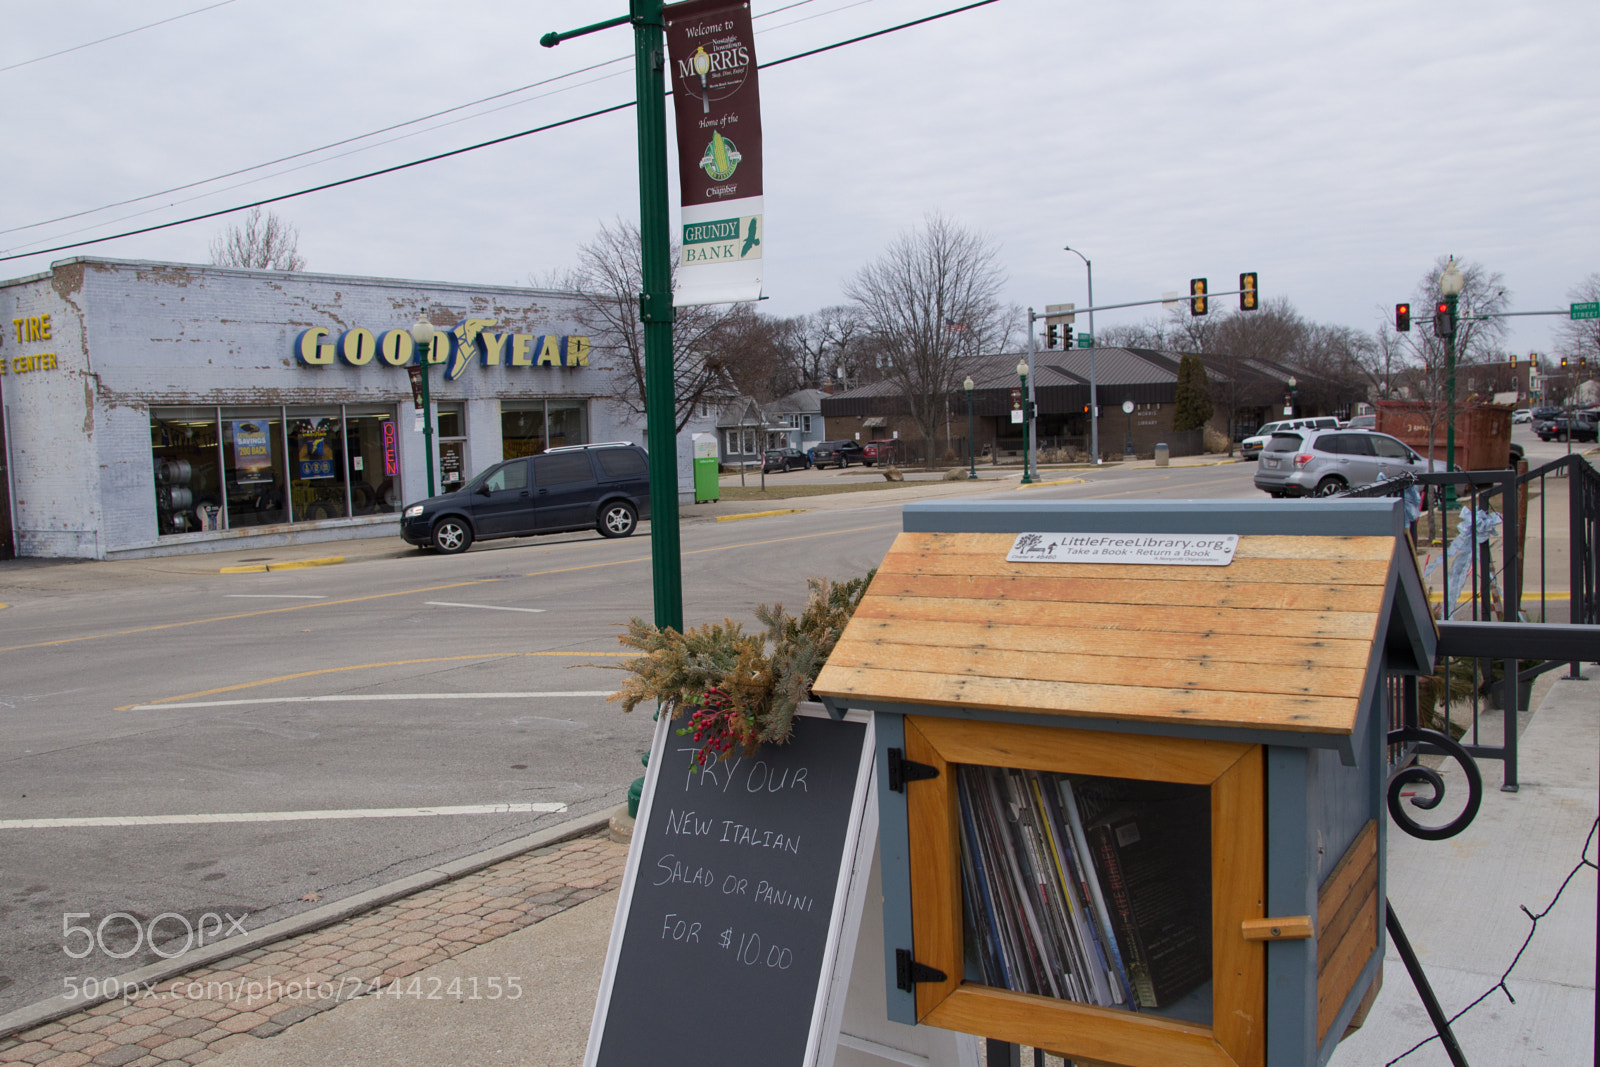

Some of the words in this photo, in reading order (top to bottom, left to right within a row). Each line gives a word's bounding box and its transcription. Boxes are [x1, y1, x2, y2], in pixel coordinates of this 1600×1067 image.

[685, 22, 722, 38] Welcome
[725, 20, 734, 30] to
[713, 42, 741, 52] Downtown
[678, 46, 749, 78] MORRIS
[699, 117, 718, 129] Home
[720, 115, 727, 129] of
[728, 112, 738, 124] the
[706, 184, 737, 198] Chamber
[685, 221, 738, 242] GRUNDY
[686, 244, 735, 262] BANK
[1573, 311, 1598, 319] STREET
[12, 313, 52, 344] TIRE
[12, 352, 58, 374] CENTER
[384, 423, 396, 475] OPEN
[1061, 536, 1225, 550] LittleFreeLibrary.org
[1067, 547, 1090, 555] Take
[1101, 548, 1128, 556] Book
[1136, 548, 1171, 556] Return
[1183, 549, 1211, 557] Book
[677, 748, 741, 792] TRY
[747, 761, 808, 792] OUR
[666, 808, 712, 836] NEW
[720, 821, 800, 854] ITALIAN
[1101, 845, 1123, 890] RUNNER
[653, 854, 714, 887] SALAD
[722, 875, 748, 895] OR
[755, 881, 813, 912] PANINI
[662, 914, 701, 943] FOR
[718, 927, 793, 969] $10.00
